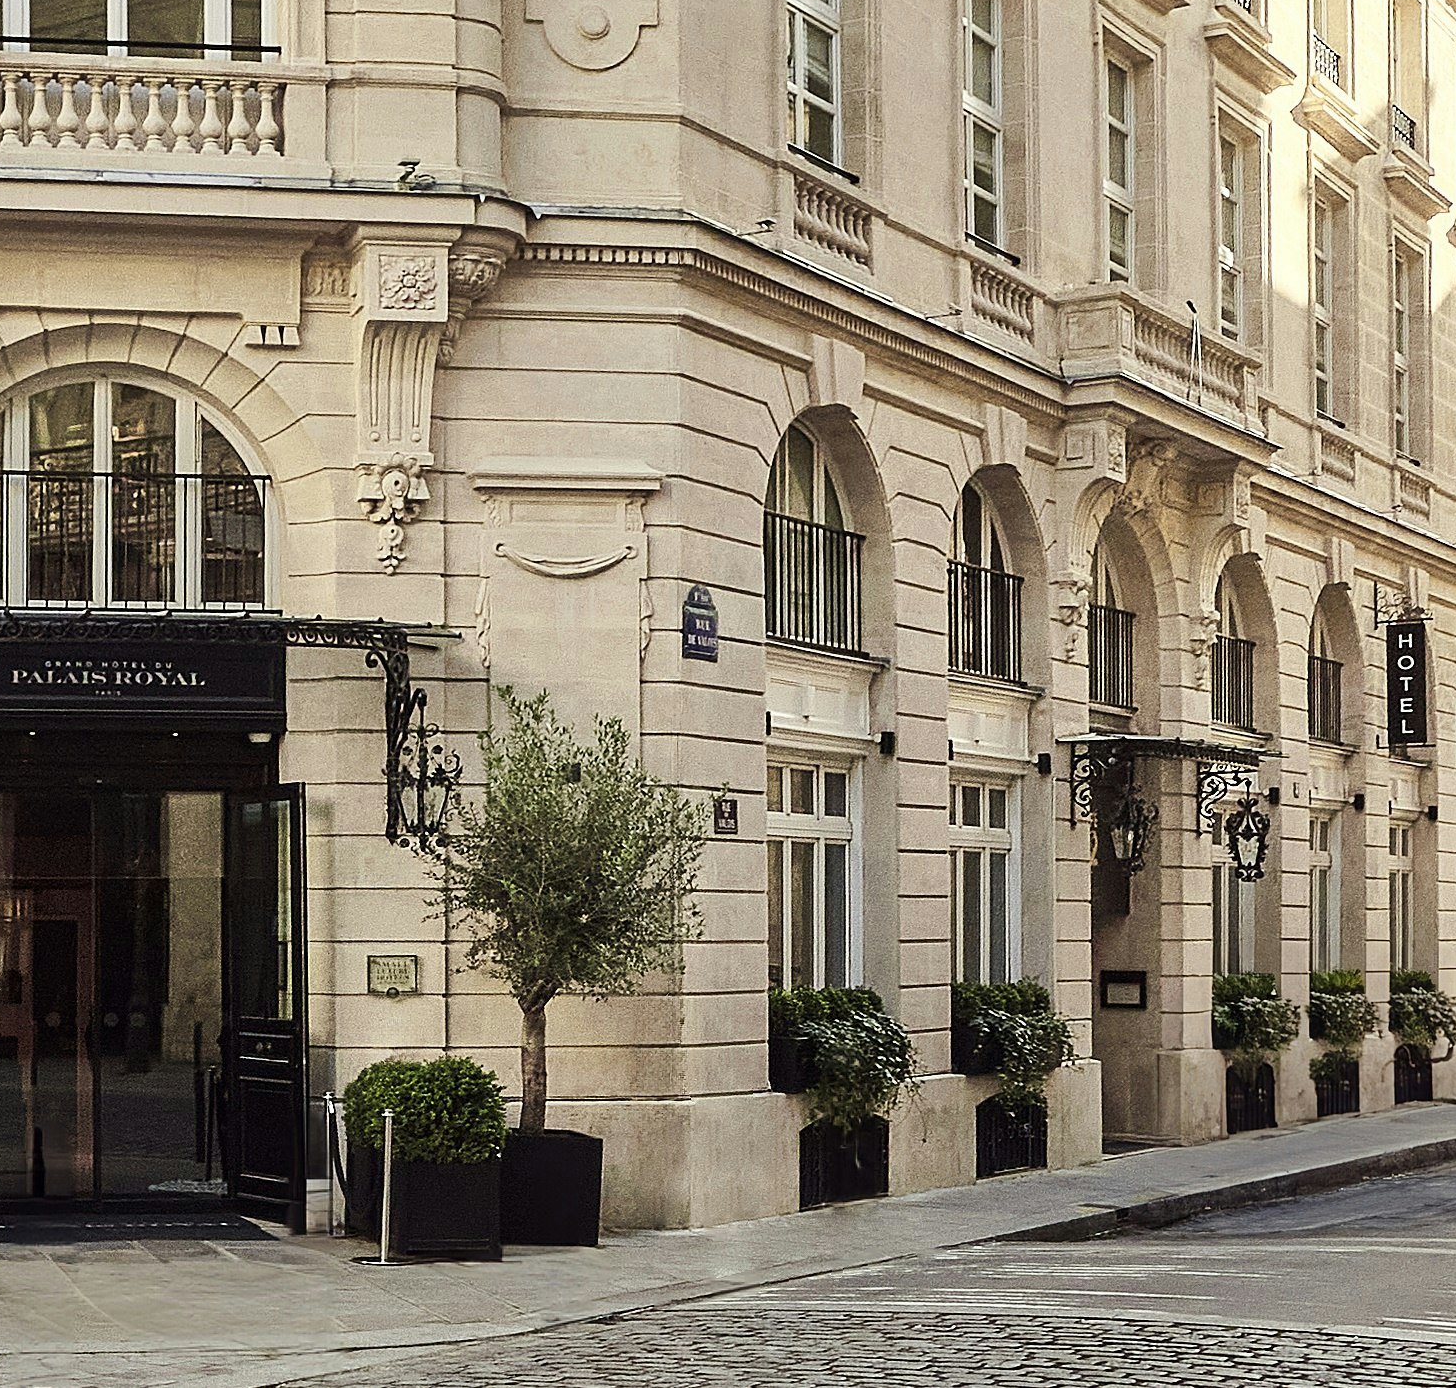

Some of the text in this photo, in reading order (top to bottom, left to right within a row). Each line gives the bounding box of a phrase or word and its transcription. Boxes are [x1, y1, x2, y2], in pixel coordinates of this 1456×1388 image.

[44, 660, 93, 668] GRAND
[11, 669, 206, 686] PALAIS ROYAL
[1397, 633, 1415, 734] HOTEL
